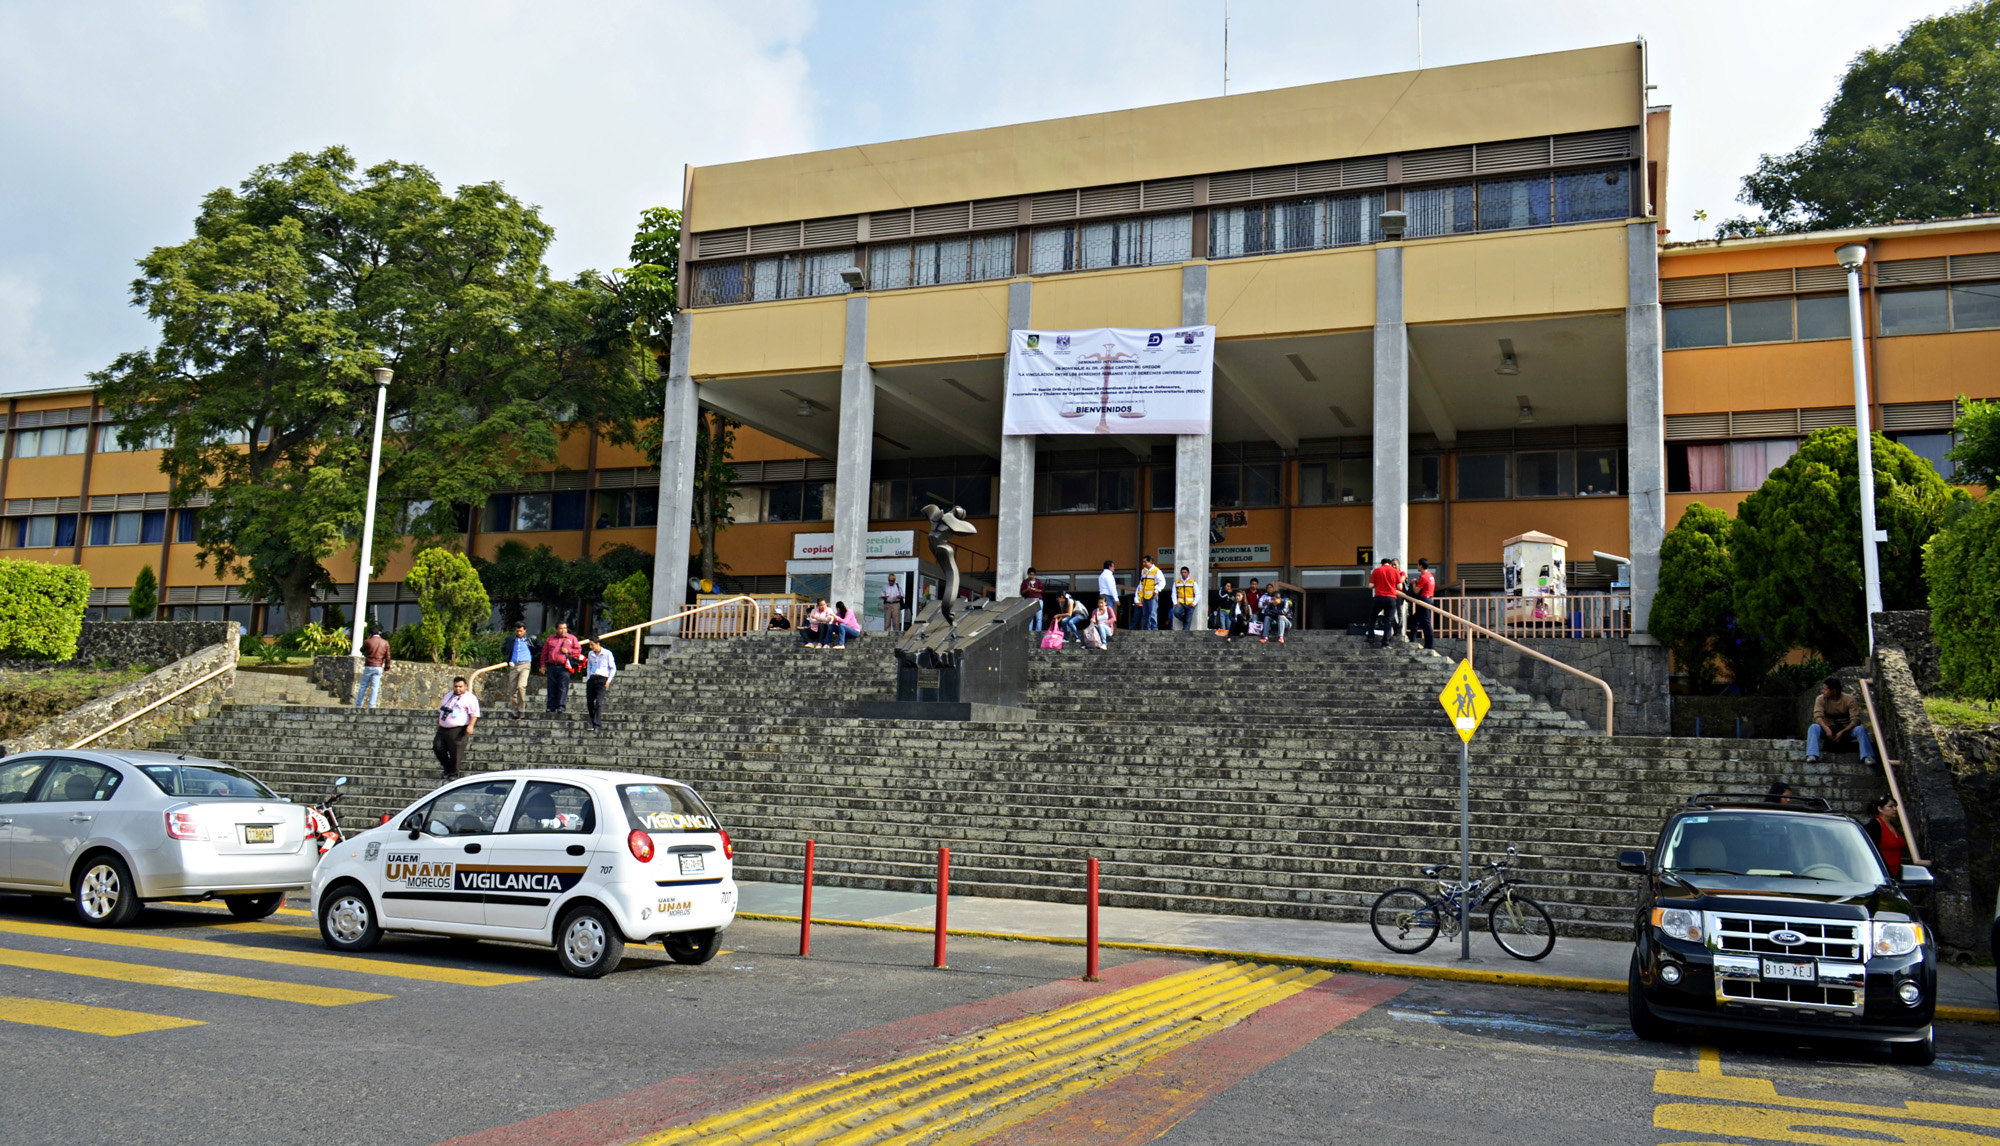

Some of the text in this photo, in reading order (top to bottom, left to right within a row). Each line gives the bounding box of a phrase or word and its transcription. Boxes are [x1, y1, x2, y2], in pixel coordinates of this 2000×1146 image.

[1362, 552, 1368, 562] 1
[638, 815, 716, 829] VIGILANCIA
[386, 863, 451, 881] UNAM
[600, 866, 613, 874] 707
[407, 877, 450, 888] MORELOS
[460, 873, 562, 890] VIGILANCIA
[658, 902, 691, 912] UNAM
[1765, 964, 1812, 977] 818-XEJ
